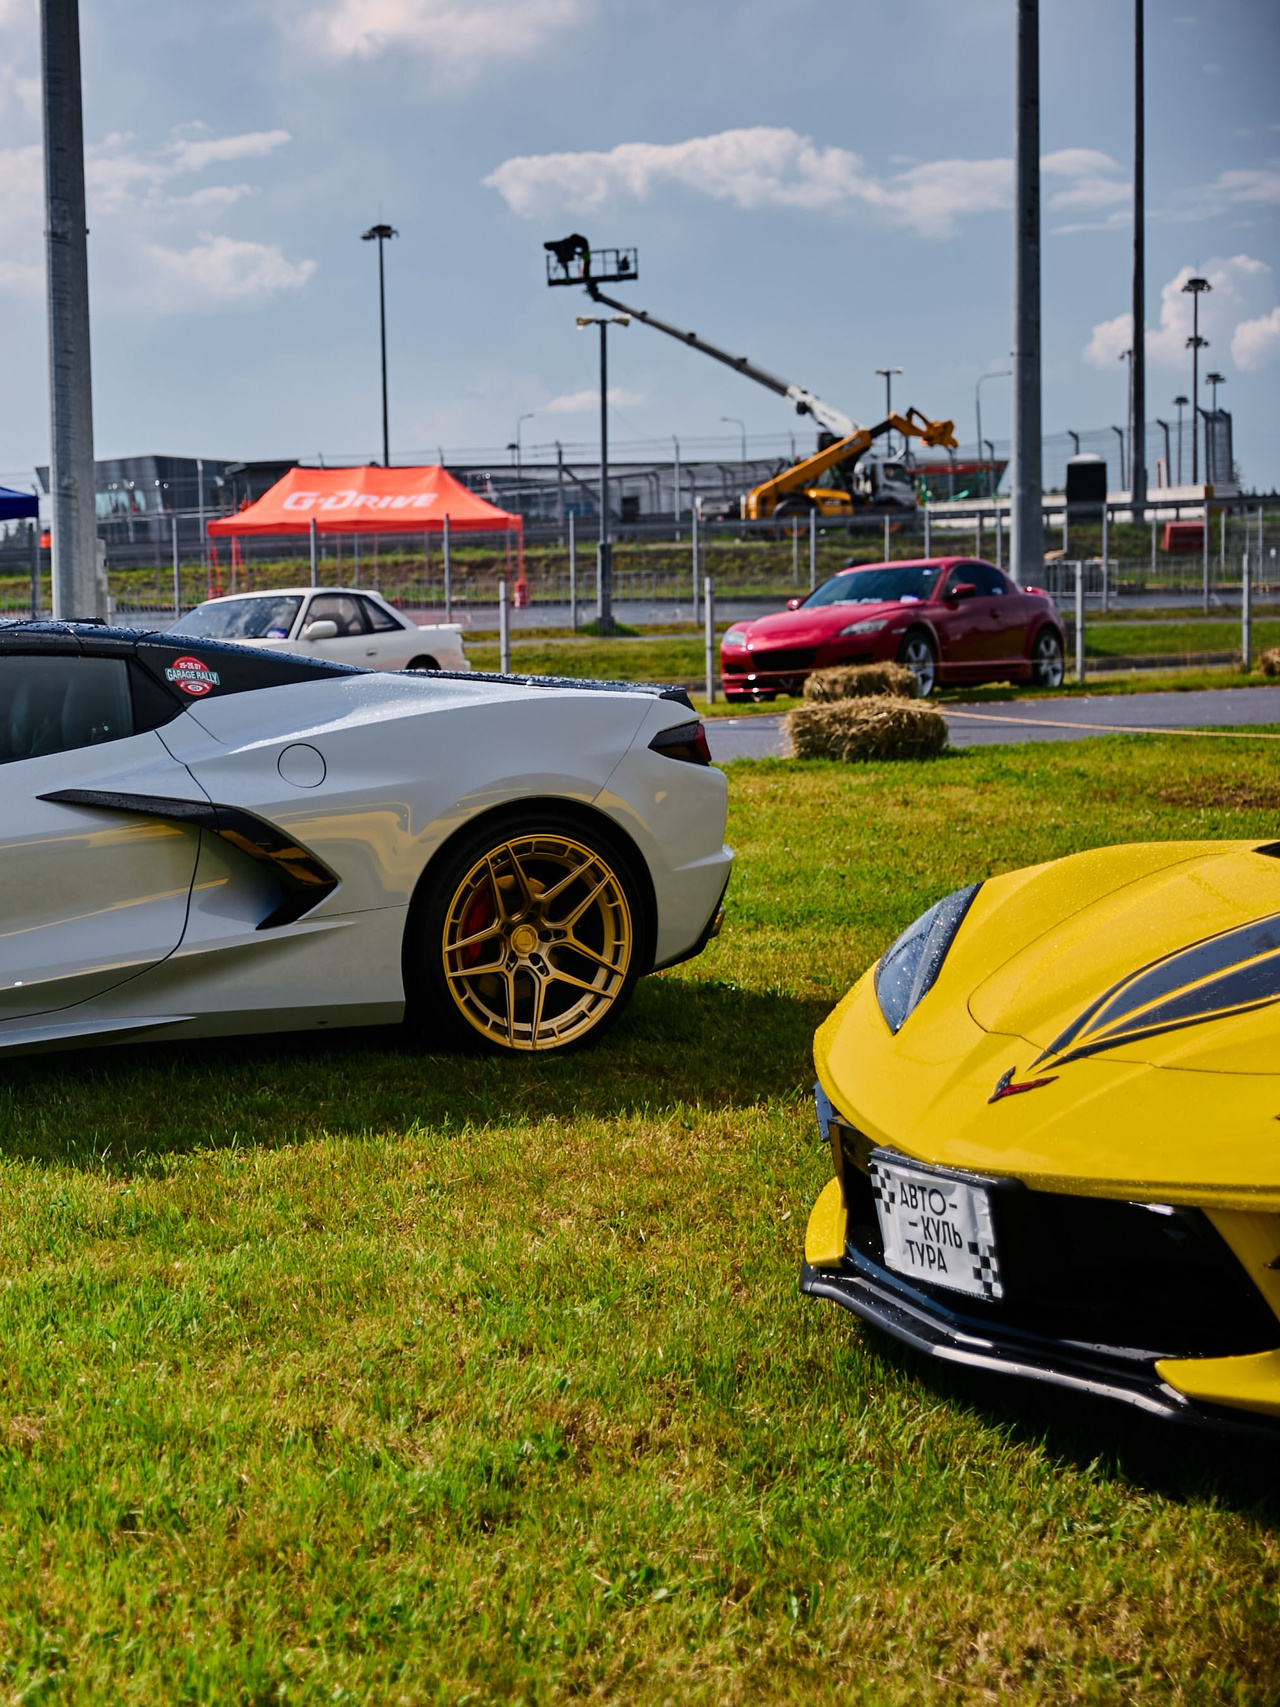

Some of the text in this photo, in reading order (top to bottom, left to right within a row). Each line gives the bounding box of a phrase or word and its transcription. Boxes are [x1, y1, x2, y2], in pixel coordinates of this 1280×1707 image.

[167, 669, 218, 684] GARAGE RALLY
[905, 1239, 948, 1273] ТУРА
